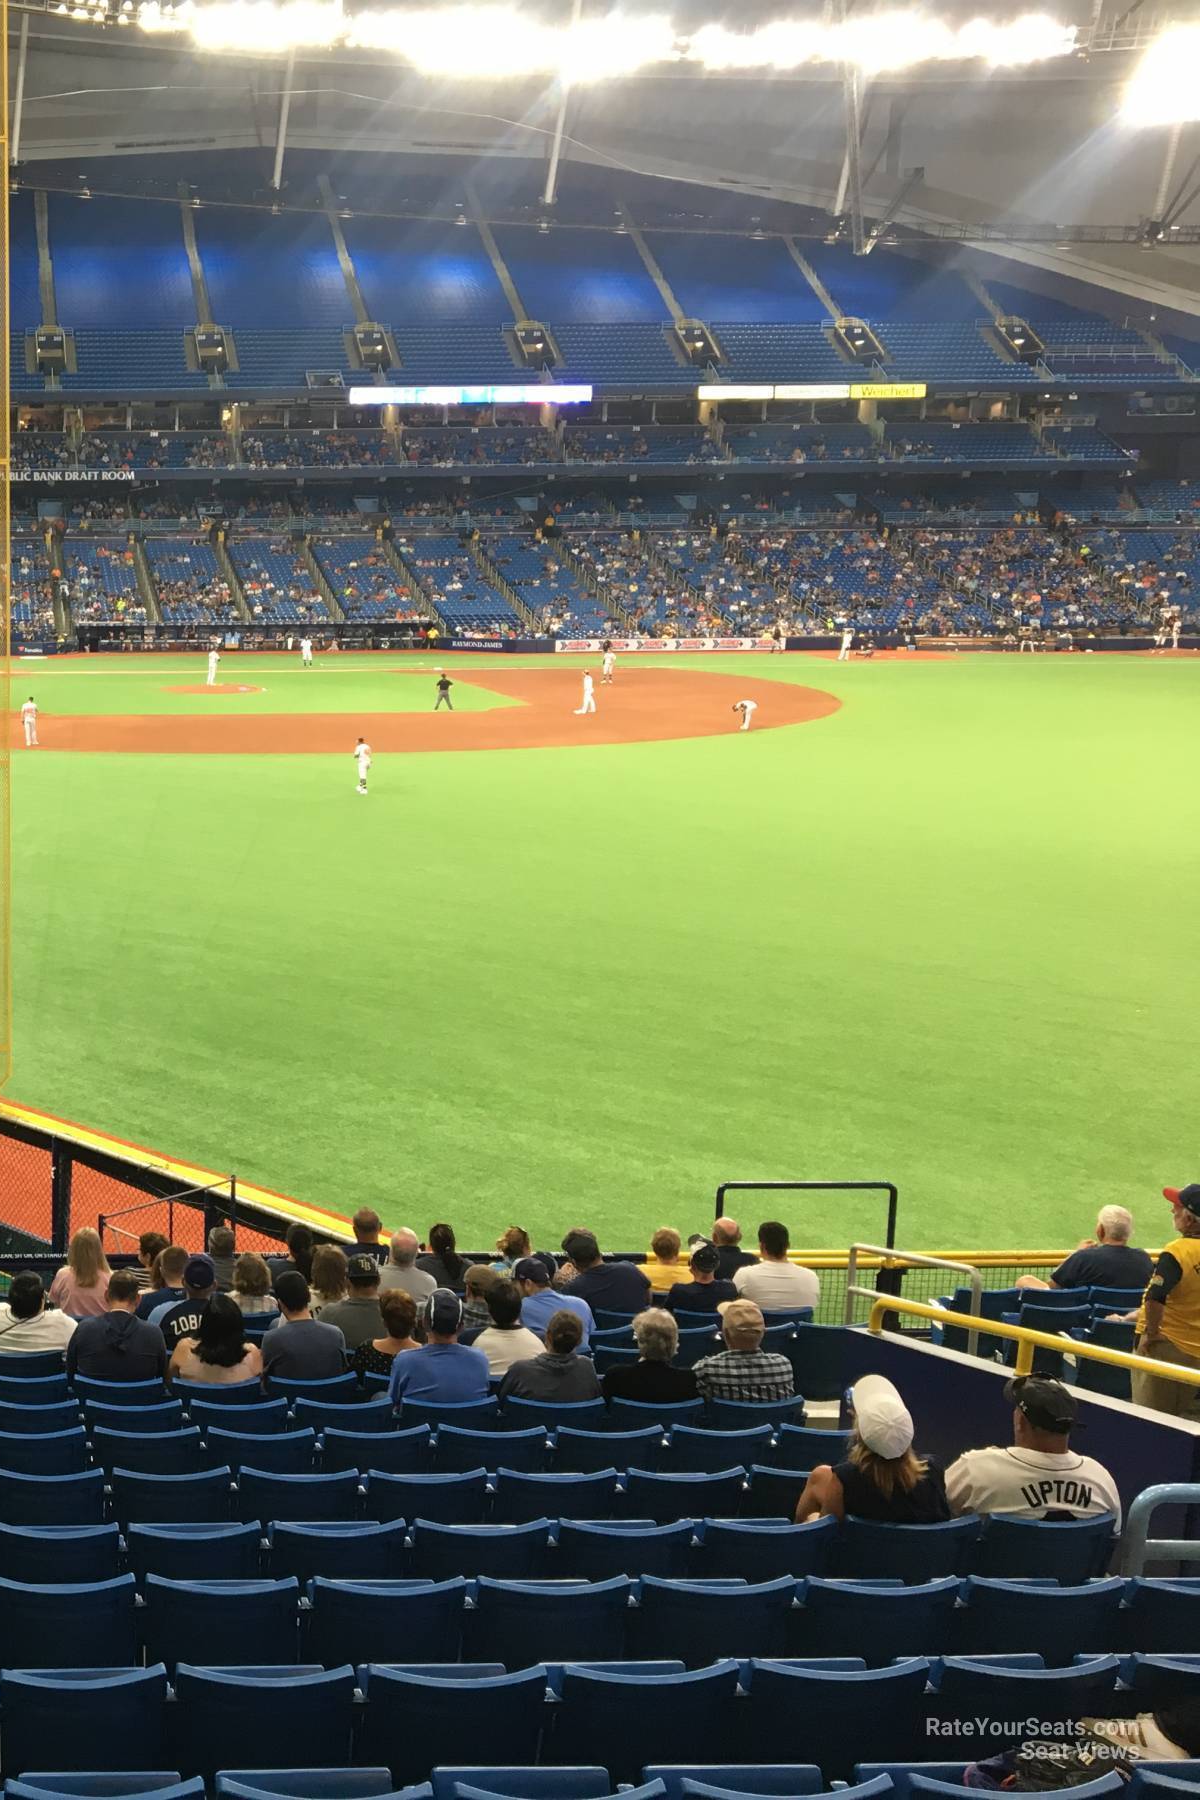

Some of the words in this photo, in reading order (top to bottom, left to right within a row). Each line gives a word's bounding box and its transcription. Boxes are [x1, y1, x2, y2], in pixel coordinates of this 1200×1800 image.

[861, 385, 916, 397] Weichert
[33, 471, 63, 481] BANK
[64, 471, 99, 481] DRAFT
[101, 471, 135, 481] ROOM
[1020, 1480, 1093, 1509] UPTON
